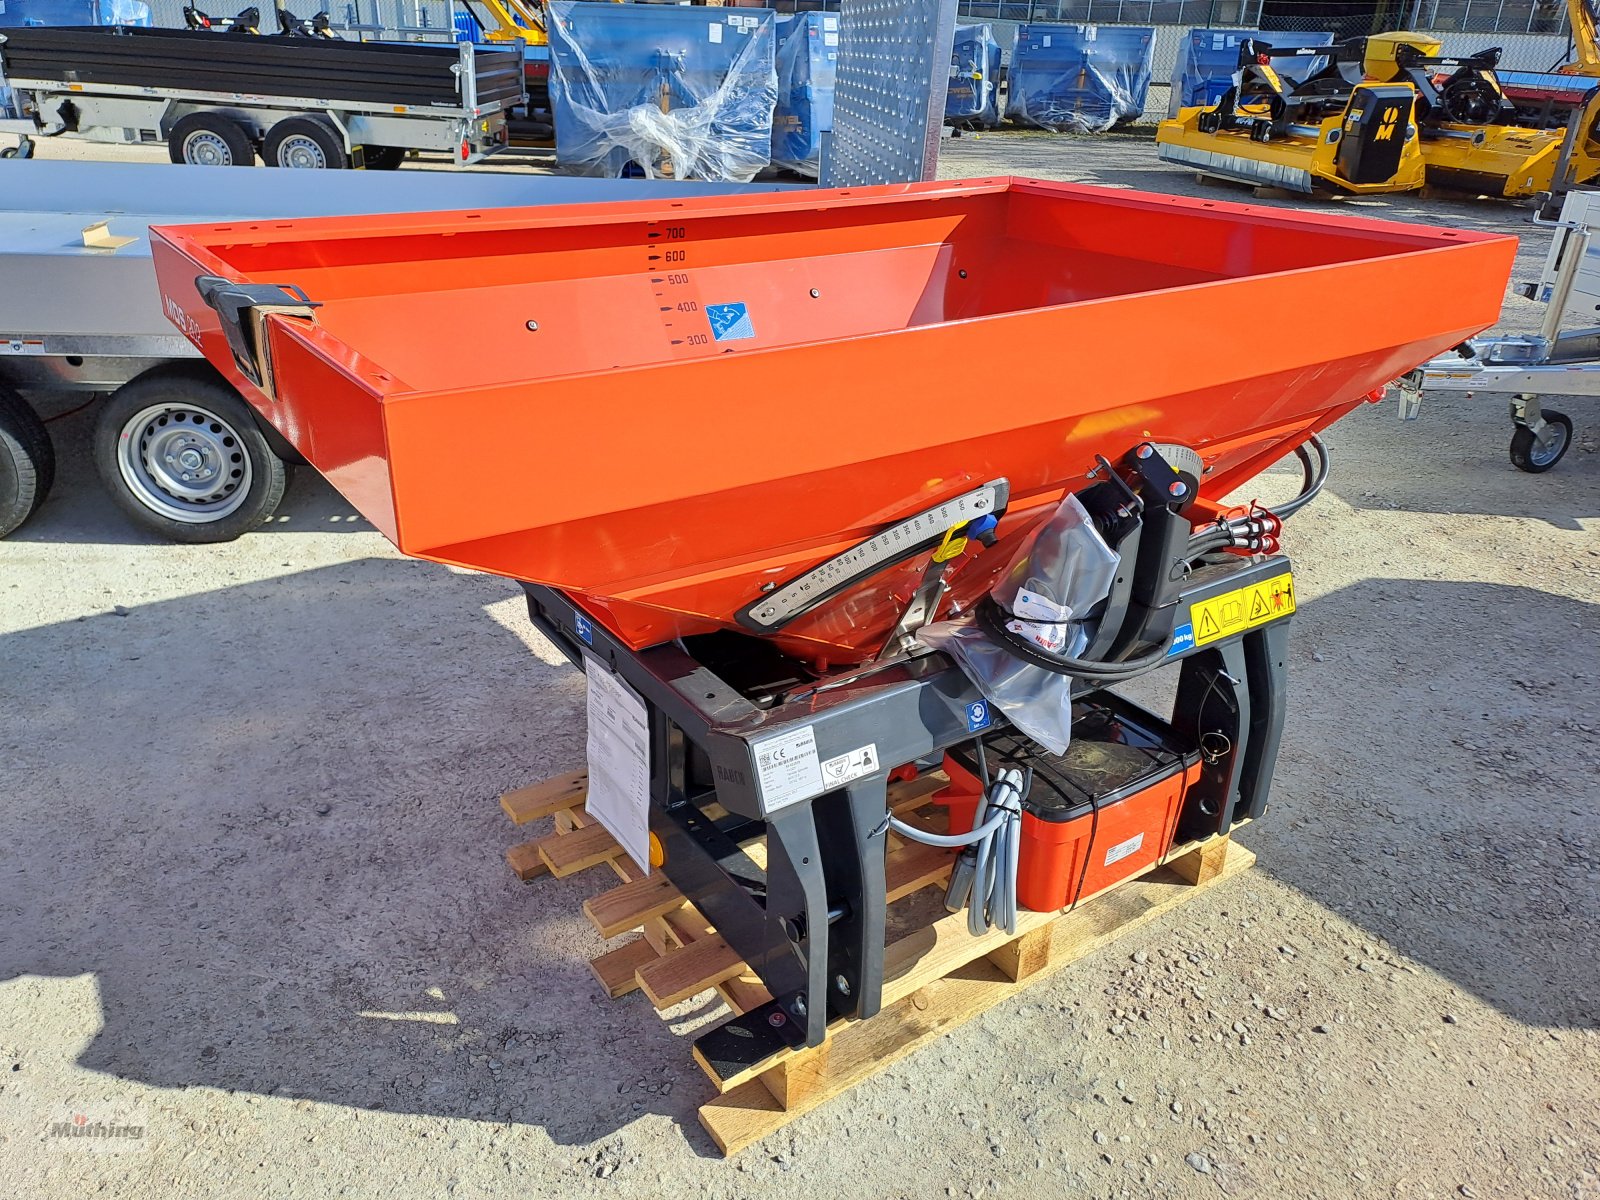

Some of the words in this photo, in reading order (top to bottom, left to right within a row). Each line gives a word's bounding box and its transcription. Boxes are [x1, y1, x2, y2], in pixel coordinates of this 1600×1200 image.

[666, 227, 685, 239] 700
[665, 250, 685, 262] 600
[668, 273, 689, 285] 500
[164, 293, 187, 332] MDS
[677, 301, 698, 312] 400
[687, 334, 708, 346] 300
[1184, 632, 1193, 642] kg
[825, 778, 840, 788] FINAL
[840, 772, 858, 783] CHECK
